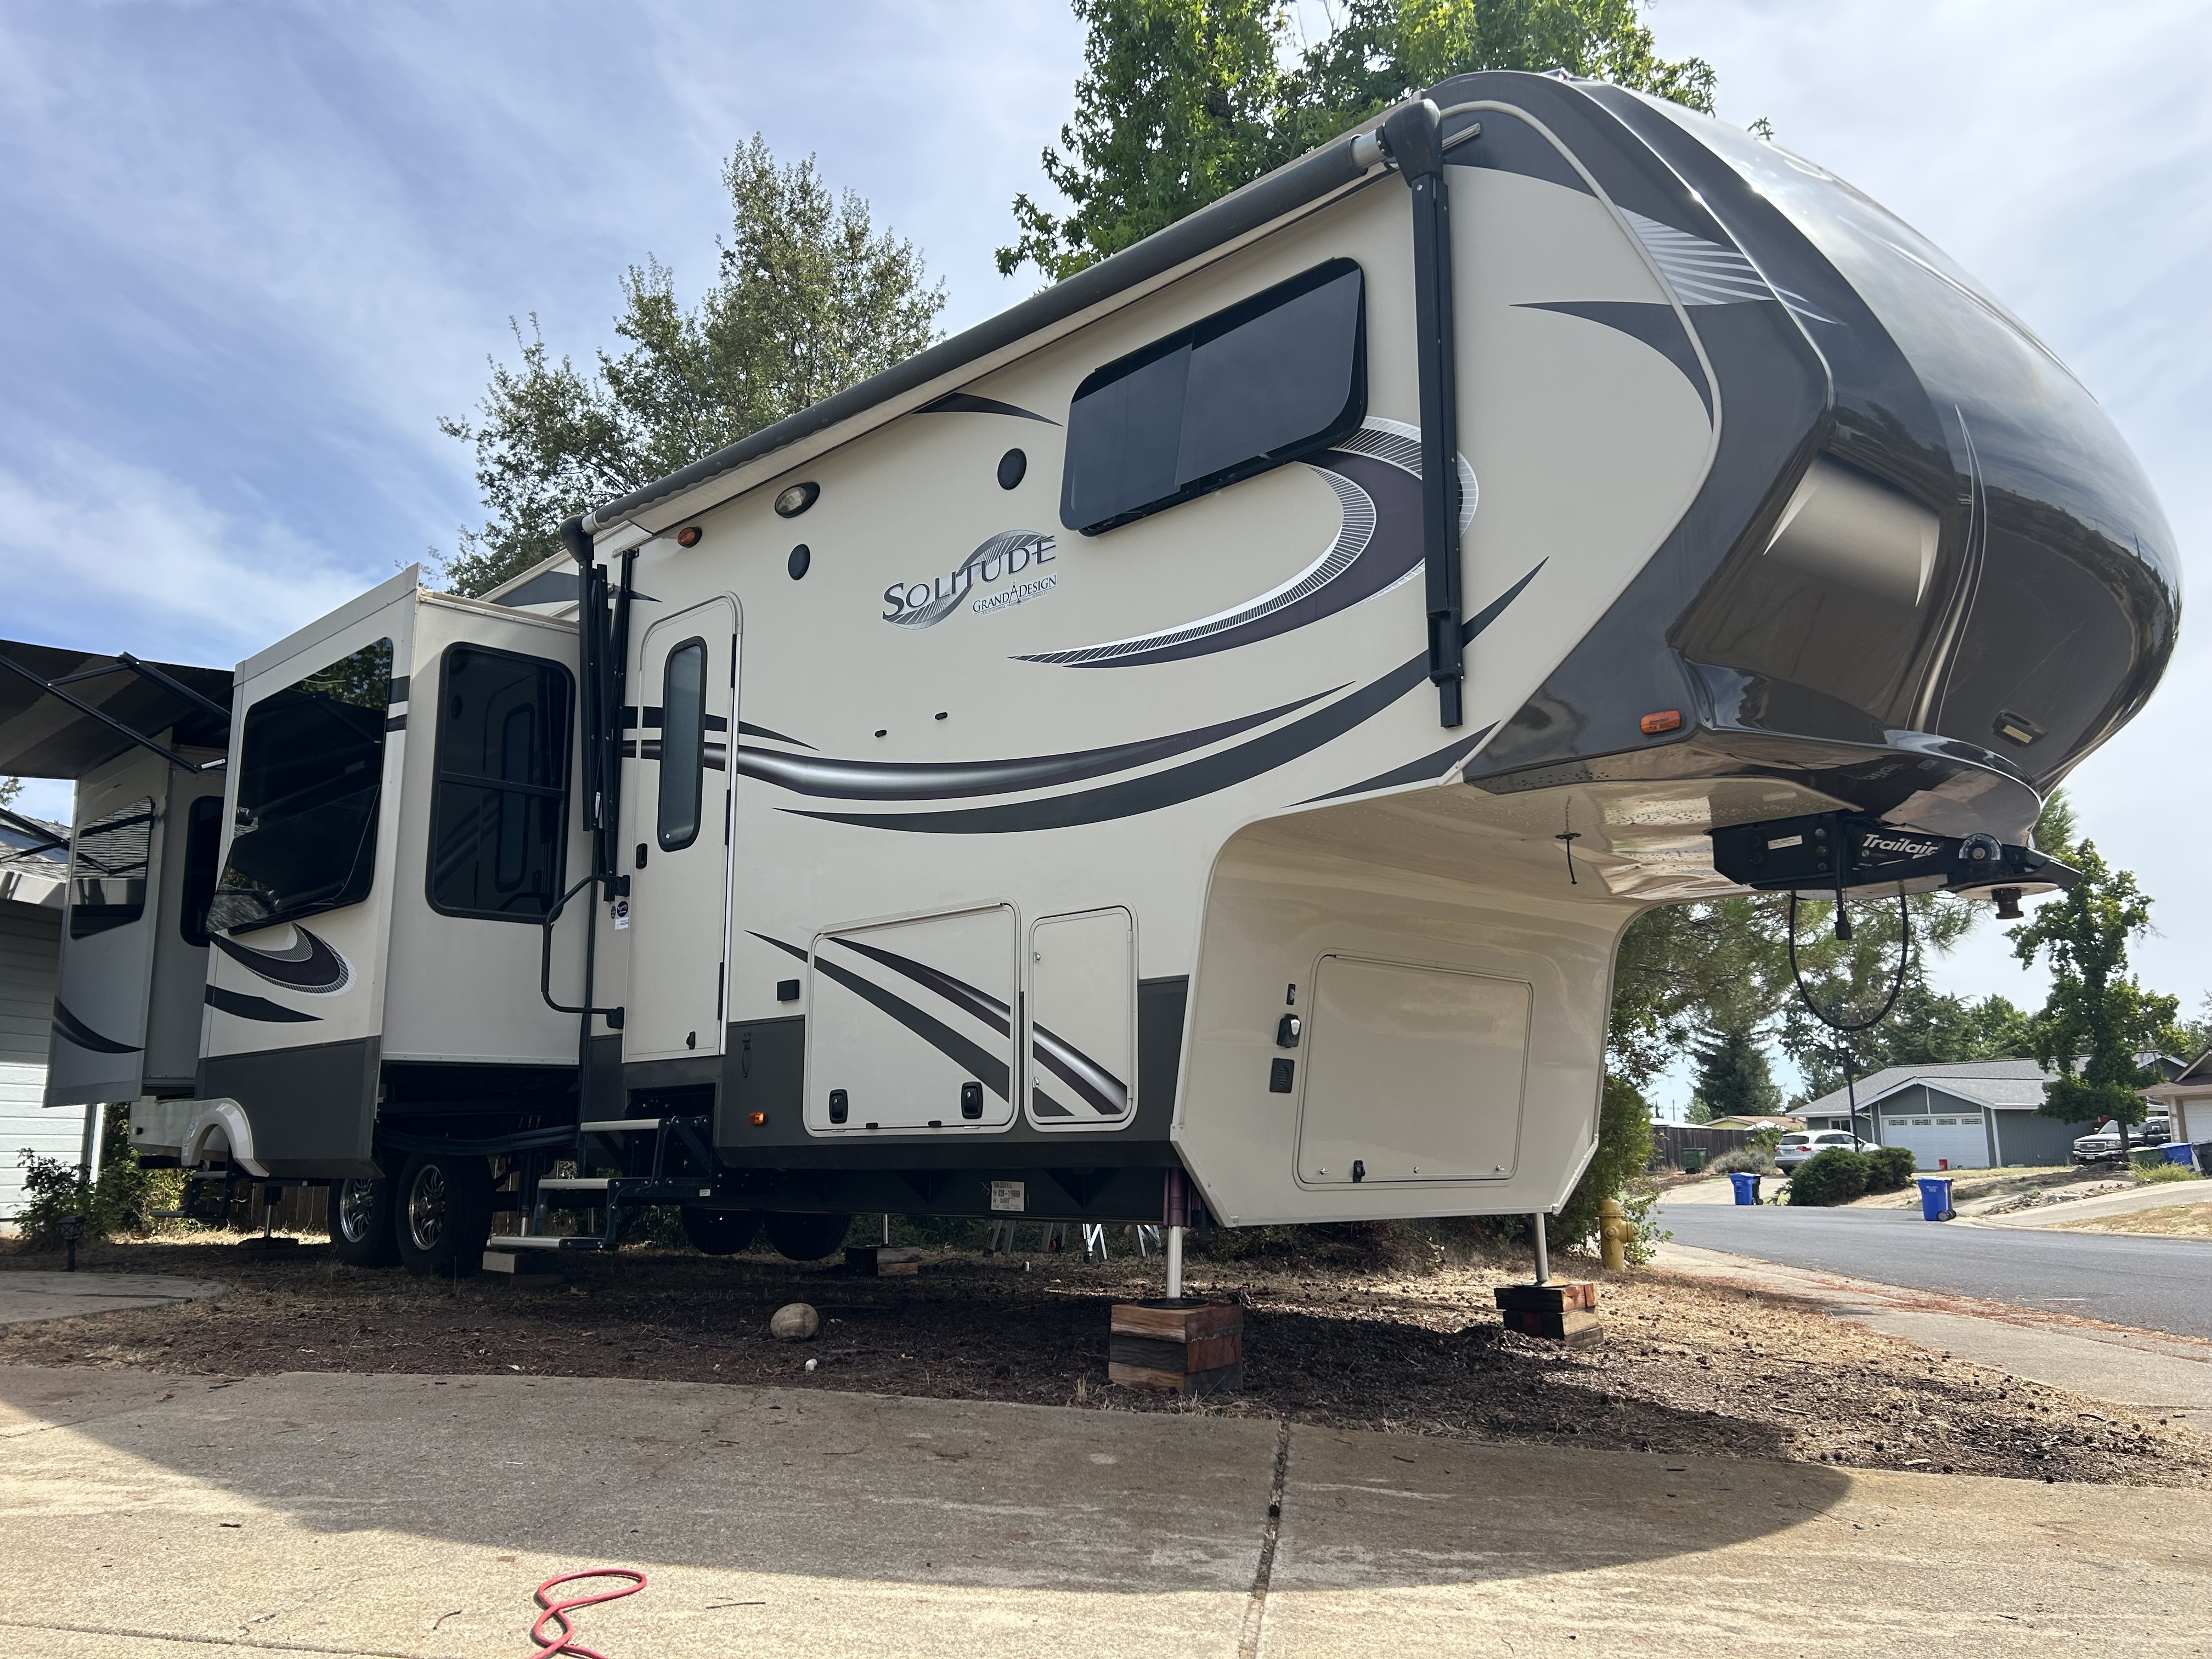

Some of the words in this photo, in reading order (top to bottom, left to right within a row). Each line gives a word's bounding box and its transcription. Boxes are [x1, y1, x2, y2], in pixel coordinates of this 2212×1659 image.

[882, 535, 1056, 620] SOLITUDE
[973, 592, 1009, 612] GRAND
[1019, 575, 1057, 597] DESIGN
[1863, 833, 1939, 855] Trailair
